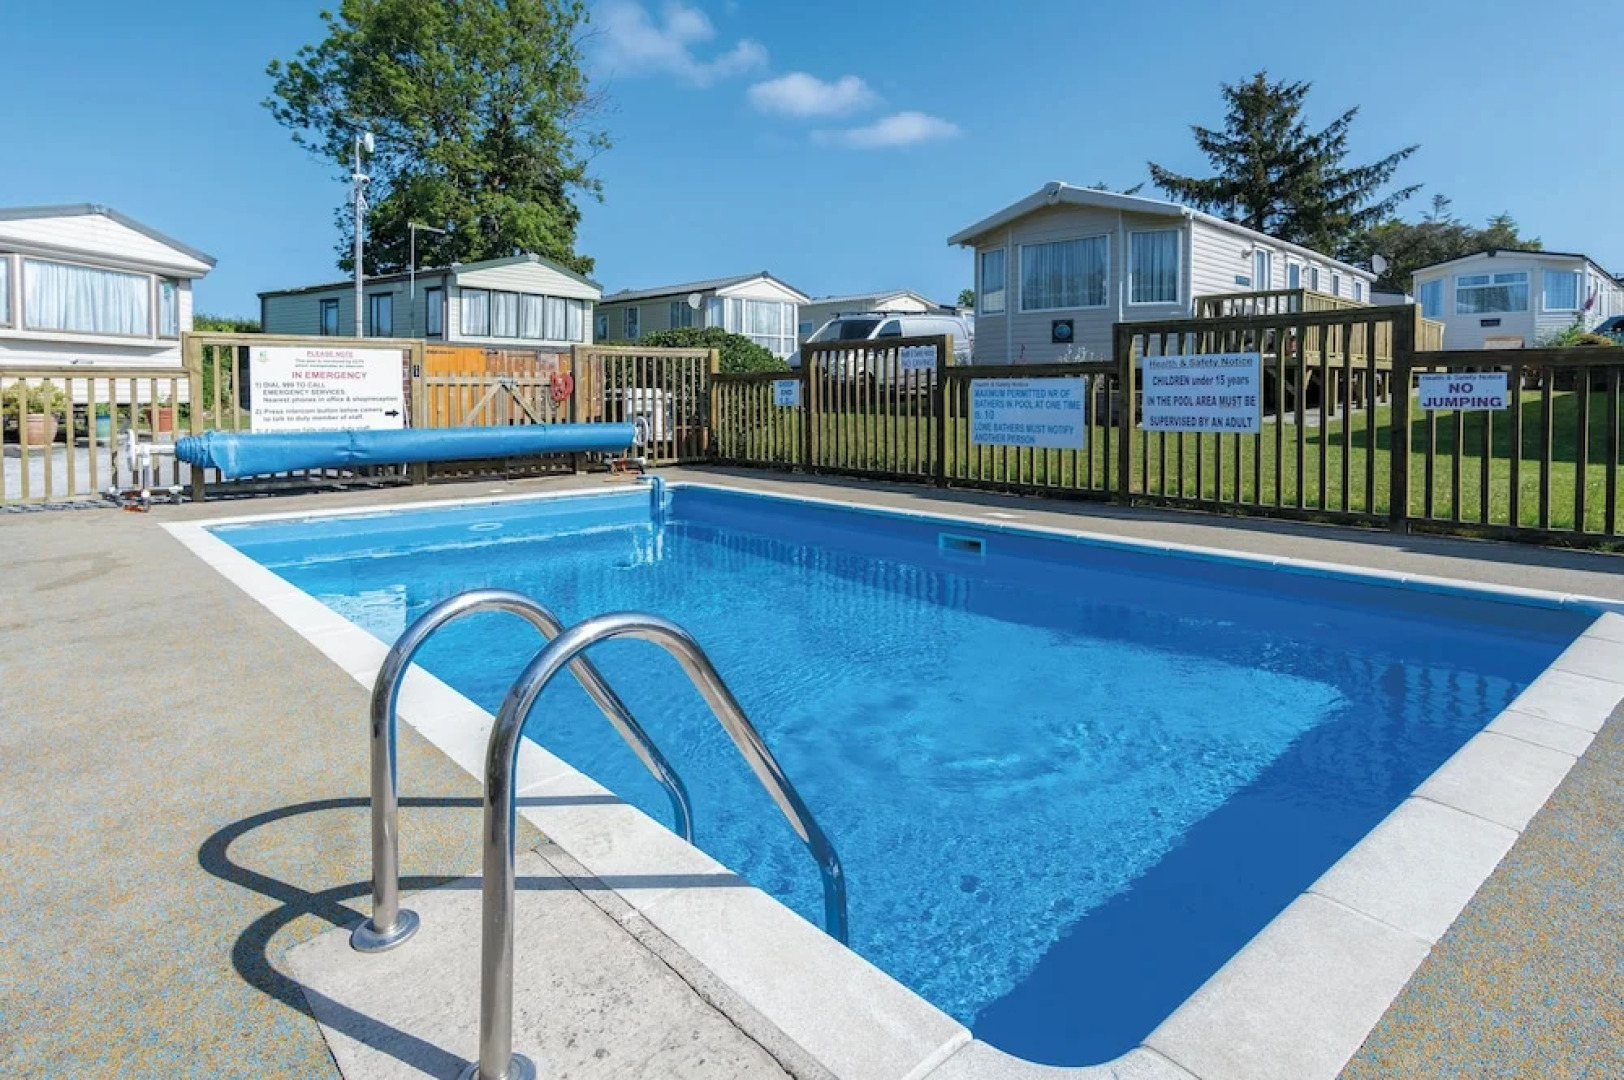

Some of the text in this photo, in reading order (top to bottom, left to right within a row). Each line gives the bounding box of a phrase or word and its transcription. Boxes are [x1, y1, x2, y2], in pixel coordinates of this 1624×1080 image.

[1149, 357, 1253, 369] Health & Safety Notice
[291, 371, 368, 379] IN EMERGENCY
[262, 381, 280, 389] DIAL
[306, 381, 326, 389] CALL
[1152, 374, 1250, 388] CHILDREN under 15 years
[1448, 382, 1474, 394] NO
[1006, 389, 1047, 399] PERMITTED
[1060, 390, 1071, 399] OF
[974, 400, 1005, 409] BATHERS
[1014, 400, 1034, 409] POOL
[1035, 401, 1044, 410] AT
[1045, 401, 1062, 410] ONE
[1062, 401, 1082, 410] TIME
[1147, 395, 1256, 408] IN THE POOL AREA MUST BE
[1422, 397, 1502, 407] JUMPING
[1149, 415, 1253, 428] SUPERVISED BY AN ADULT
[974, 423, 1075, 436] LONE BATHERS MUST NOTIFY
[974, 433, 1037, 444] ANOTHER PERSON
